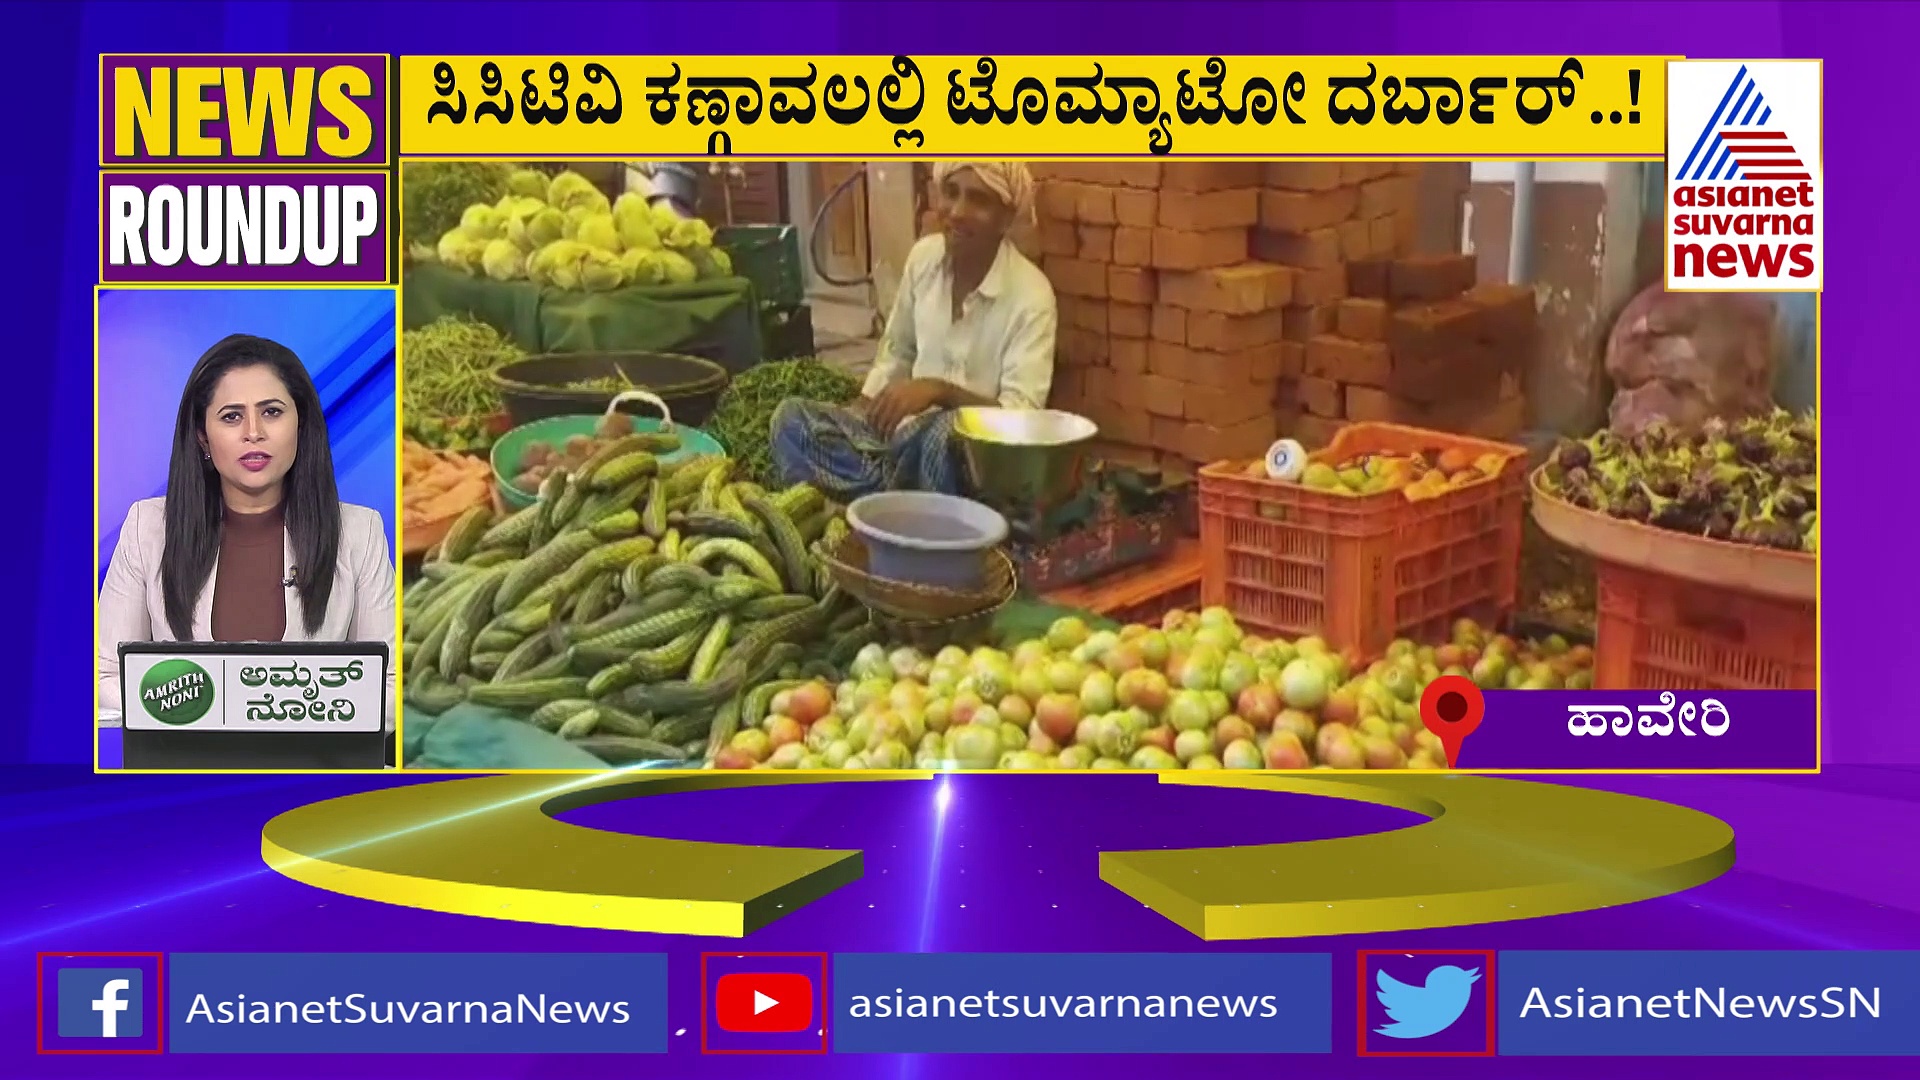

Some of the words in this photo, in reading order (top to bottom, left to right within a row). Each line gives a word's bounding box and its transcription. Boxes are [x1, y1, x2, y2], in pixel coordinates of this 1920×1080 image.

[144, 672, 205, 700] AMRITH
[239, 659, 364, 701] ಅಮೃತ್
[246, 693, 356, 722] ನೋನಿ
